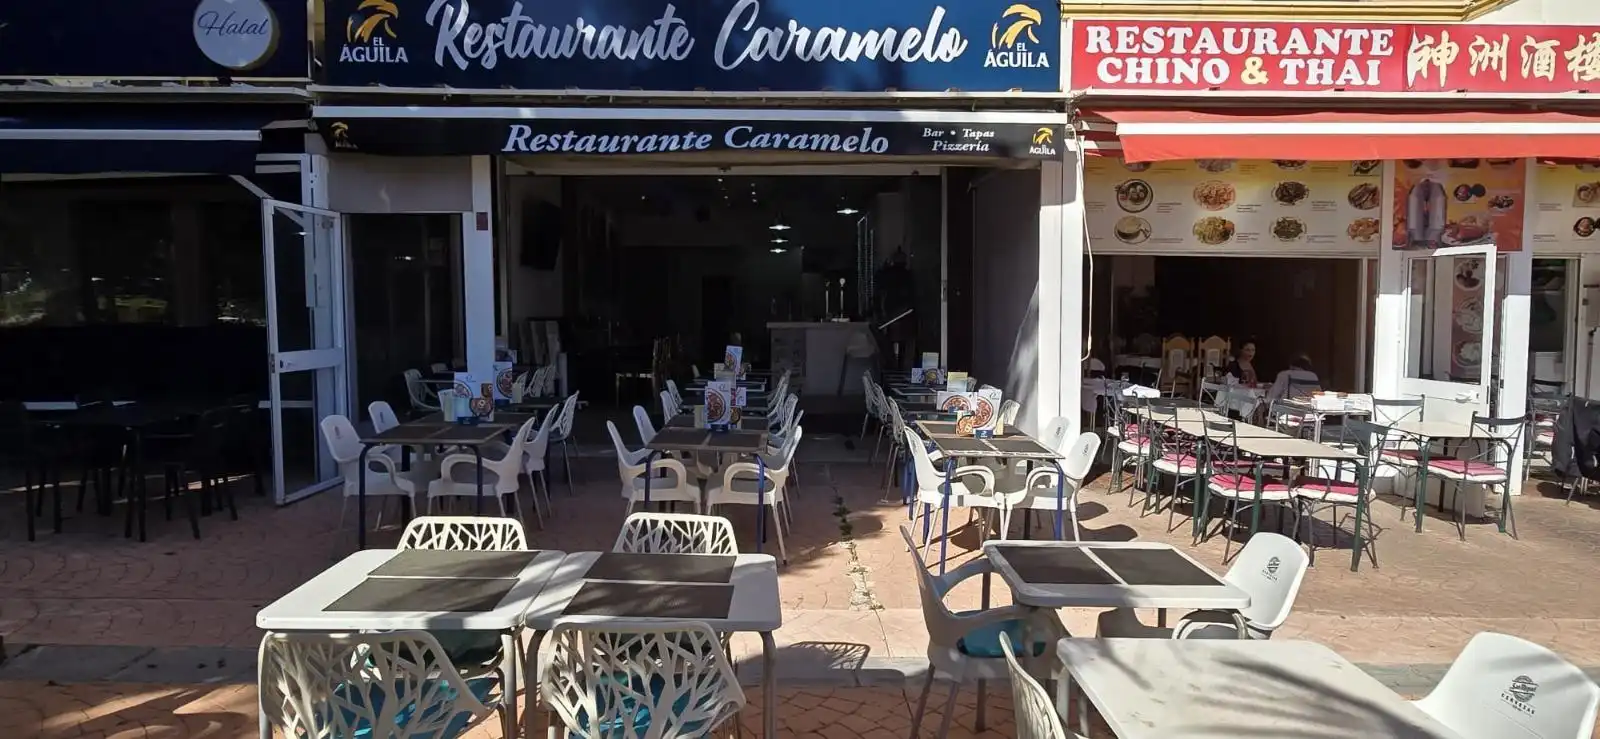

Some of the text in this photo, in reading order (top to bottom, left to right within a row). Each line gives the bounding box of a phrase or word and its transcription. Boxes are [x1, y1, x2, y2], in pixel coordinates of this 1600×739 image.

[197, 10, 269, 37] Halal
[373, 37, 384, 46] EL
[425, 0, 968, 71] Restaurante Caramelo
[1084, 26, 1393, 55] RESTAURANTE
[339, 44, 408, 63] ÁGUILA
[1016, 42, 1028, 52] EL
[984, 49, 1050, 68] ÁGUILA
[1096, 57, 1381, 86] CHINO & THAI
[501, 125, 889, 154] Restaurante Caramelo
[922, 128, 995, 140] Bar Tapas
[932, 139, 990, 153] Pizzería
